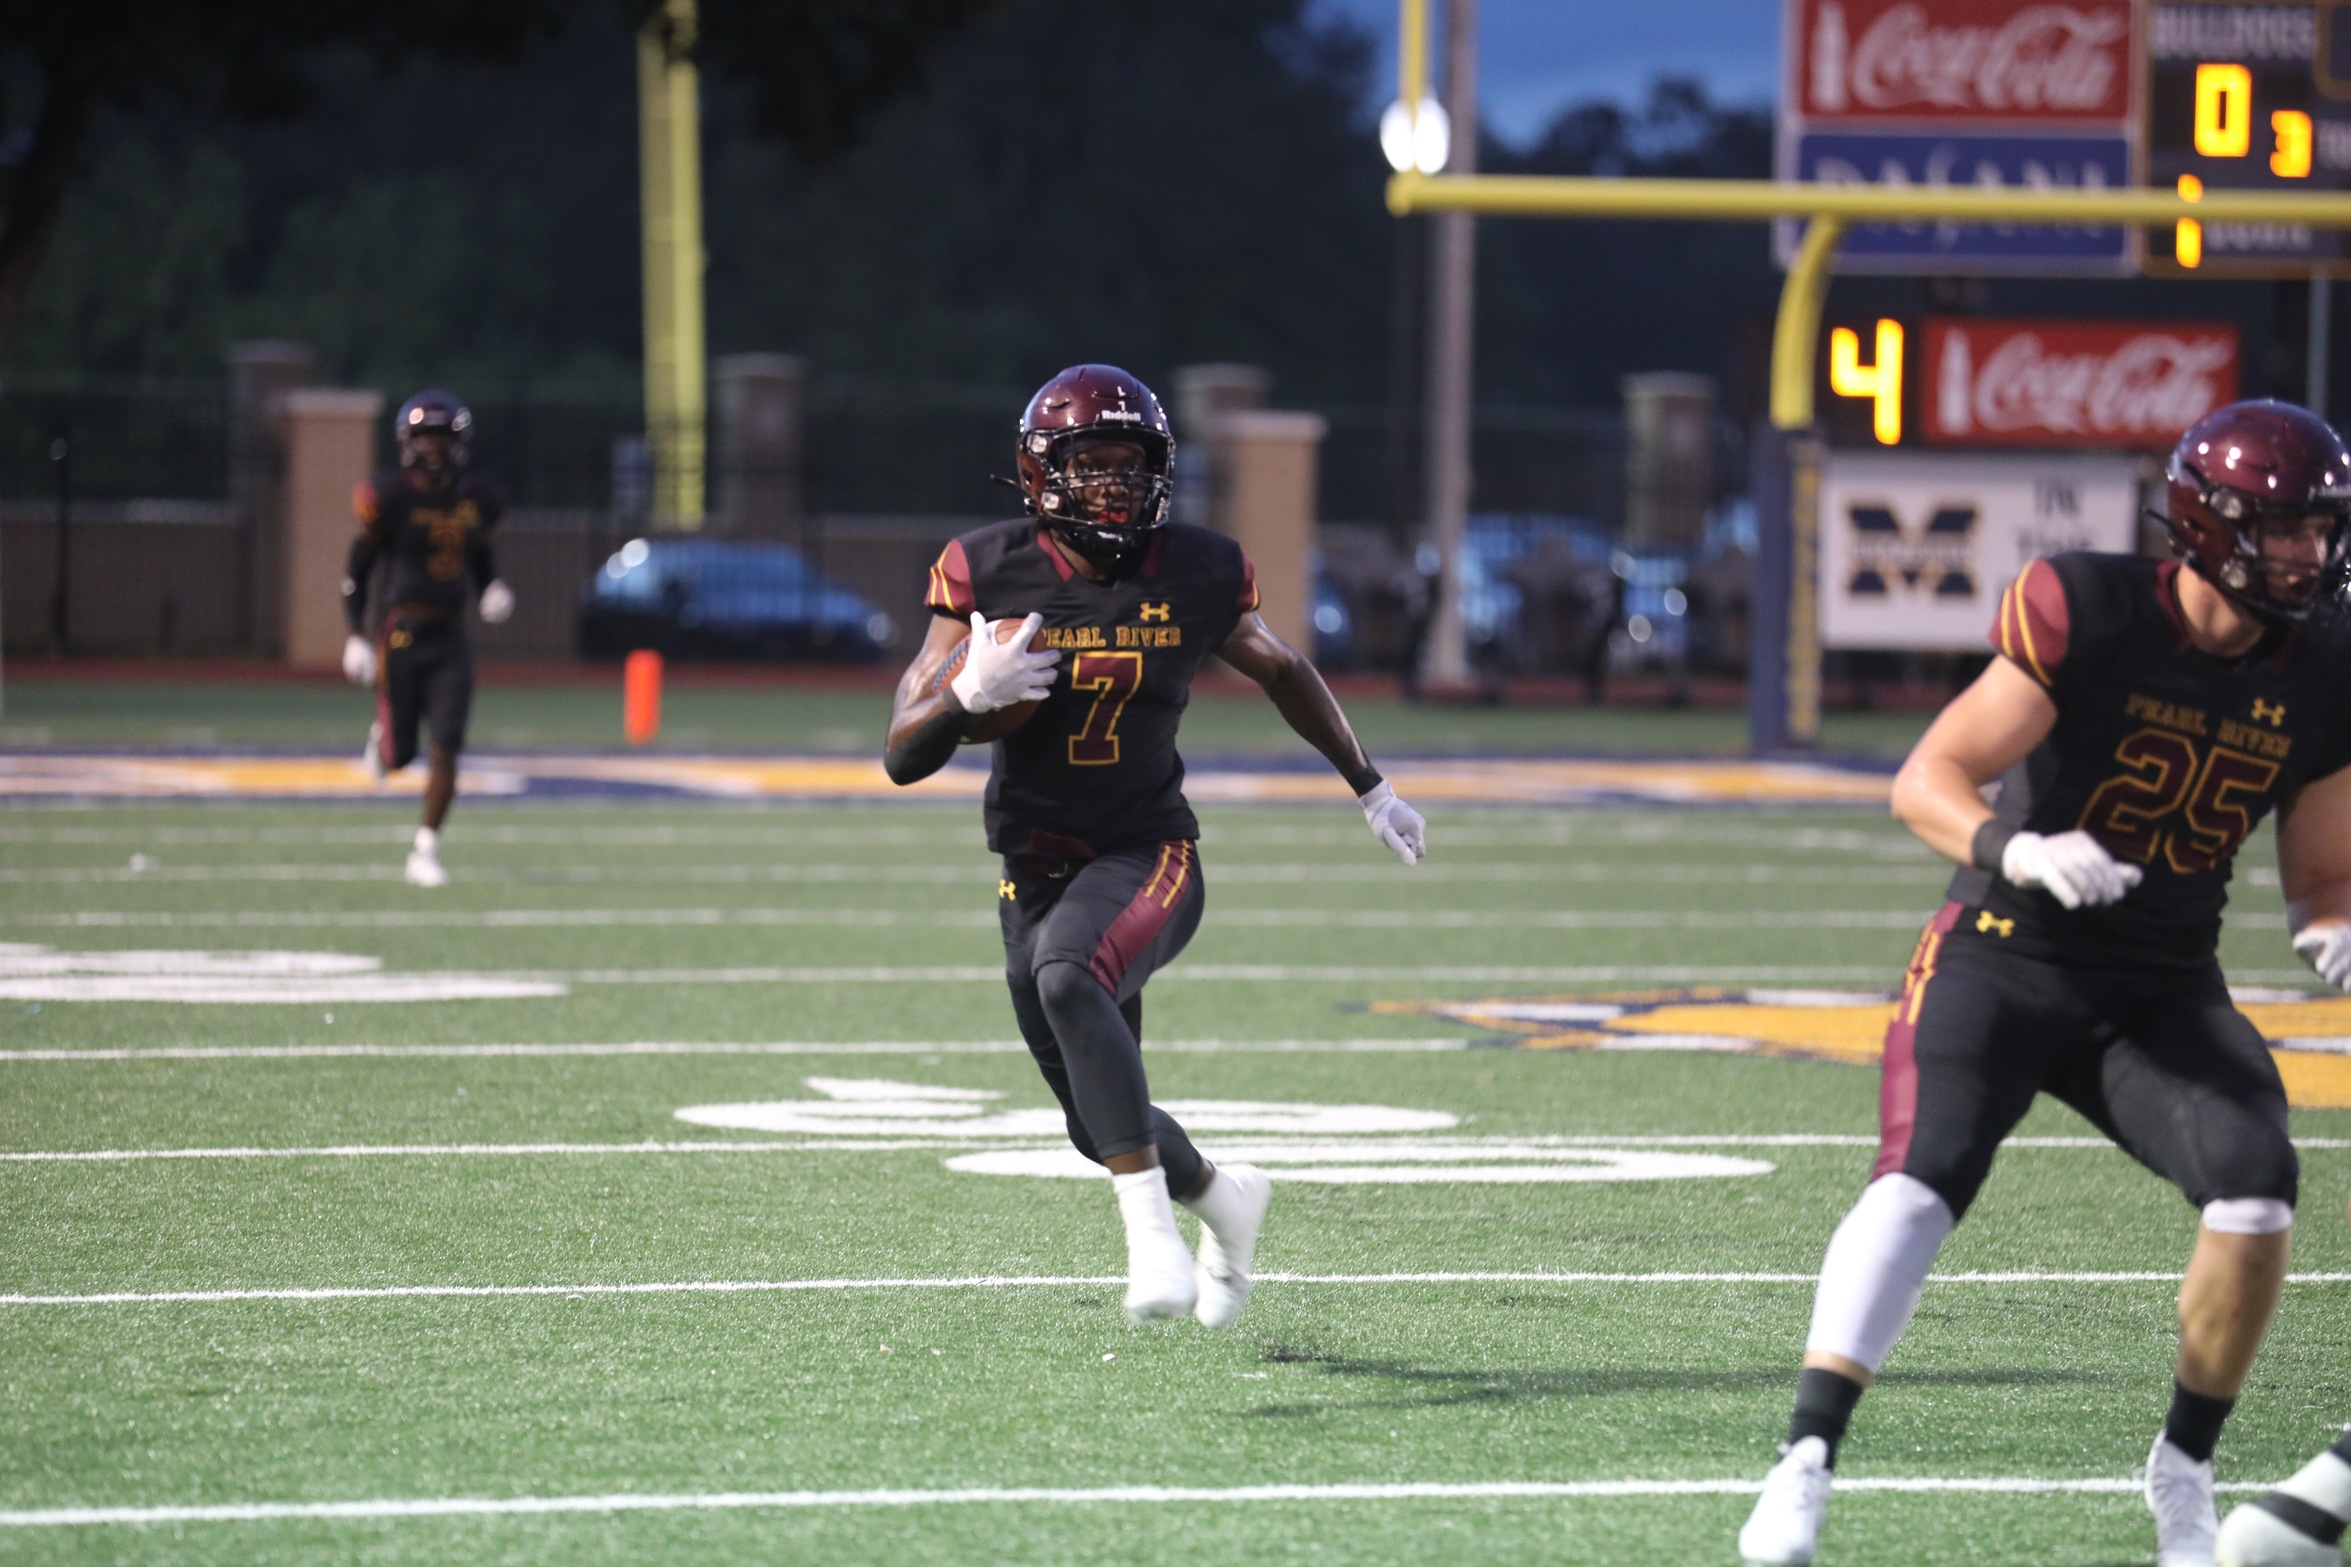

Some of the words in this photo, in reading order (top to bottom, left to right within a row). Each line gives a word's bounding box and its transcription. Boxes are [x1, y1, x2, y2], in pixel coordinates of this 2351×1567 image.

[2194, 63, 2252, 157] 0
[2268, 110, 2313, 178] 3
[1831, 318, 1904, 445] 4
[1043, 626, 1107, 648] EARL
[1115, 625, 1182, 647] RIVER
[1068, 651, 1142, 766] 7
[2076, 727, 2281, 875] 25
